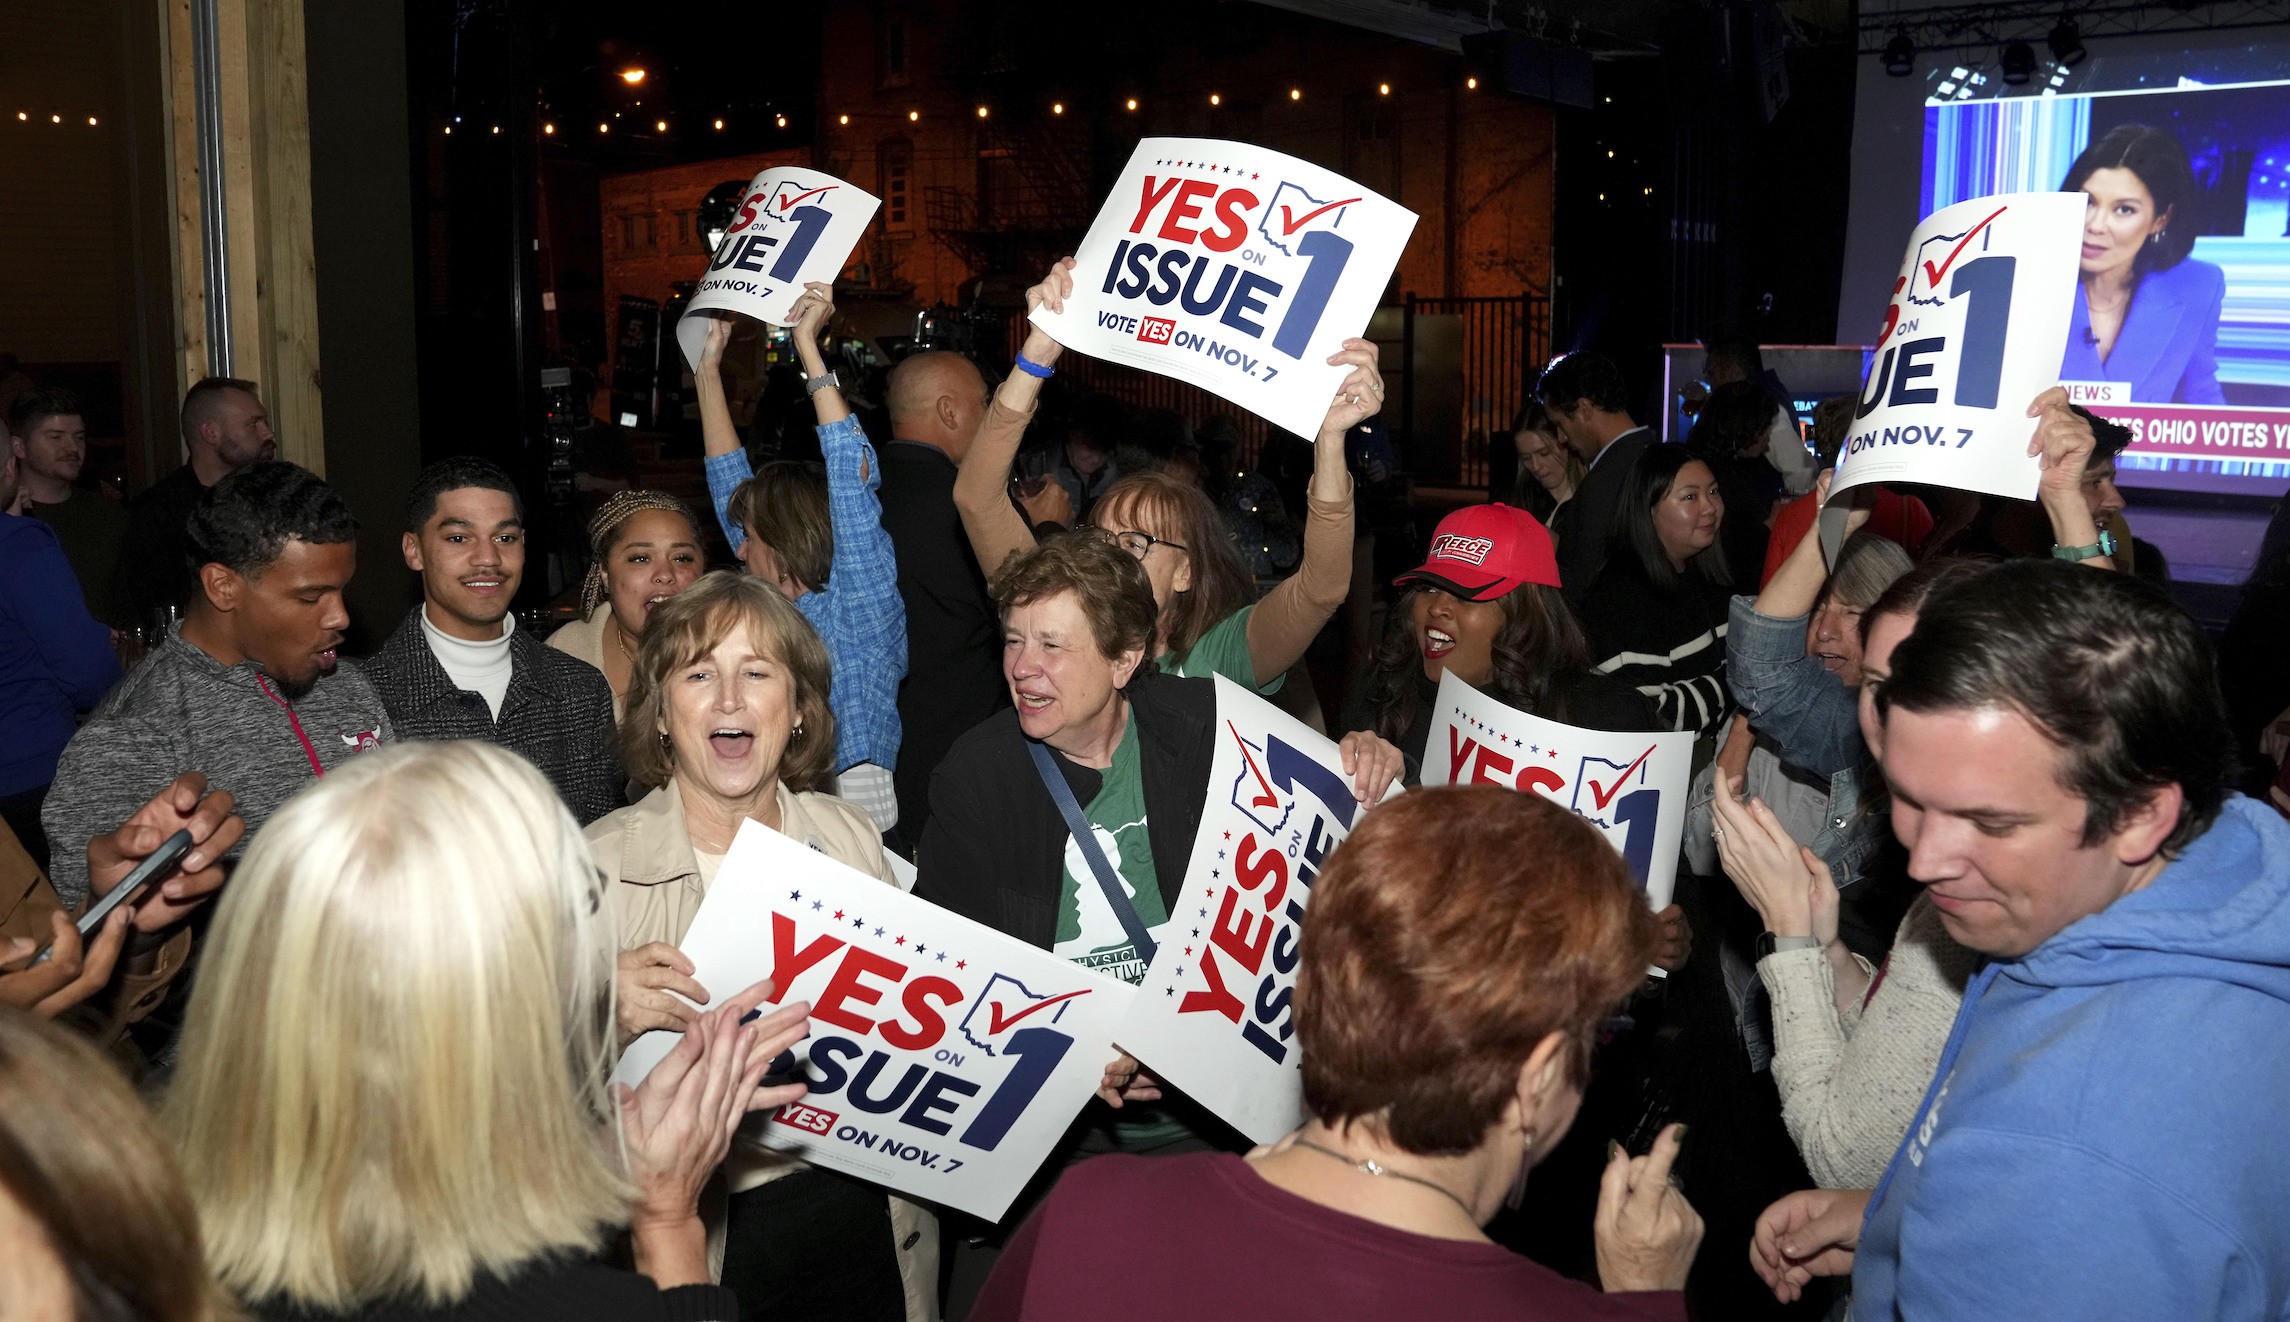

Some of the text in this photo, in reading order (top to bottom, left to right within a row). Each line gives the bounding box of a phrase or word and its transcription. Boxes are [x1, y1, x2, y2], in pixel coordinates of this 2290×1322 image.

[751, 223, 767, 231] ON
[769, 205, 833, 284] 1
[1129, 175, 1260, 252] YES
[703, 280, 773, 297] ON NOV. 7
[1102, 239, 1284, 339] ISSUE
[1242, 249, 1266, 266] ON
[1271, 231, 1354, 360] 1
[1897, 318, 1919, 336] ON
[1098, 311, 1138, 334] VOTE
[1140, 318, 1173, 343] YES
[1174, 331, 1205, 352] ON
[1206, 341, 1258, 377] NOV.
[1262, 366, 1278, 383] 7
[1949, 256, 2017, 410] 1
[1851, 425, 1974, 455] ON NOV. 7
[2147, 418, 2196, 445] OHIO
[2201, 421, 2268, 448] VOTES
[1433, 536, 1490, 556] REECE
[1288, 829, 1303, 858] ON
[1613, 789, 1660, 893] 1
[1177, 832, 1289, 1025] YES
[766, 910, 964, 1051] YES
[935, 1049, 965, 1067] ON
[959, 1027, 1075, 1152] 1
[782, 1104, 833, 1132] YES
[836, 1125, 879, 1149] ON
[878, 1138, 941, 1169] NOV.
[942, 1159, 964, 1174] 7
